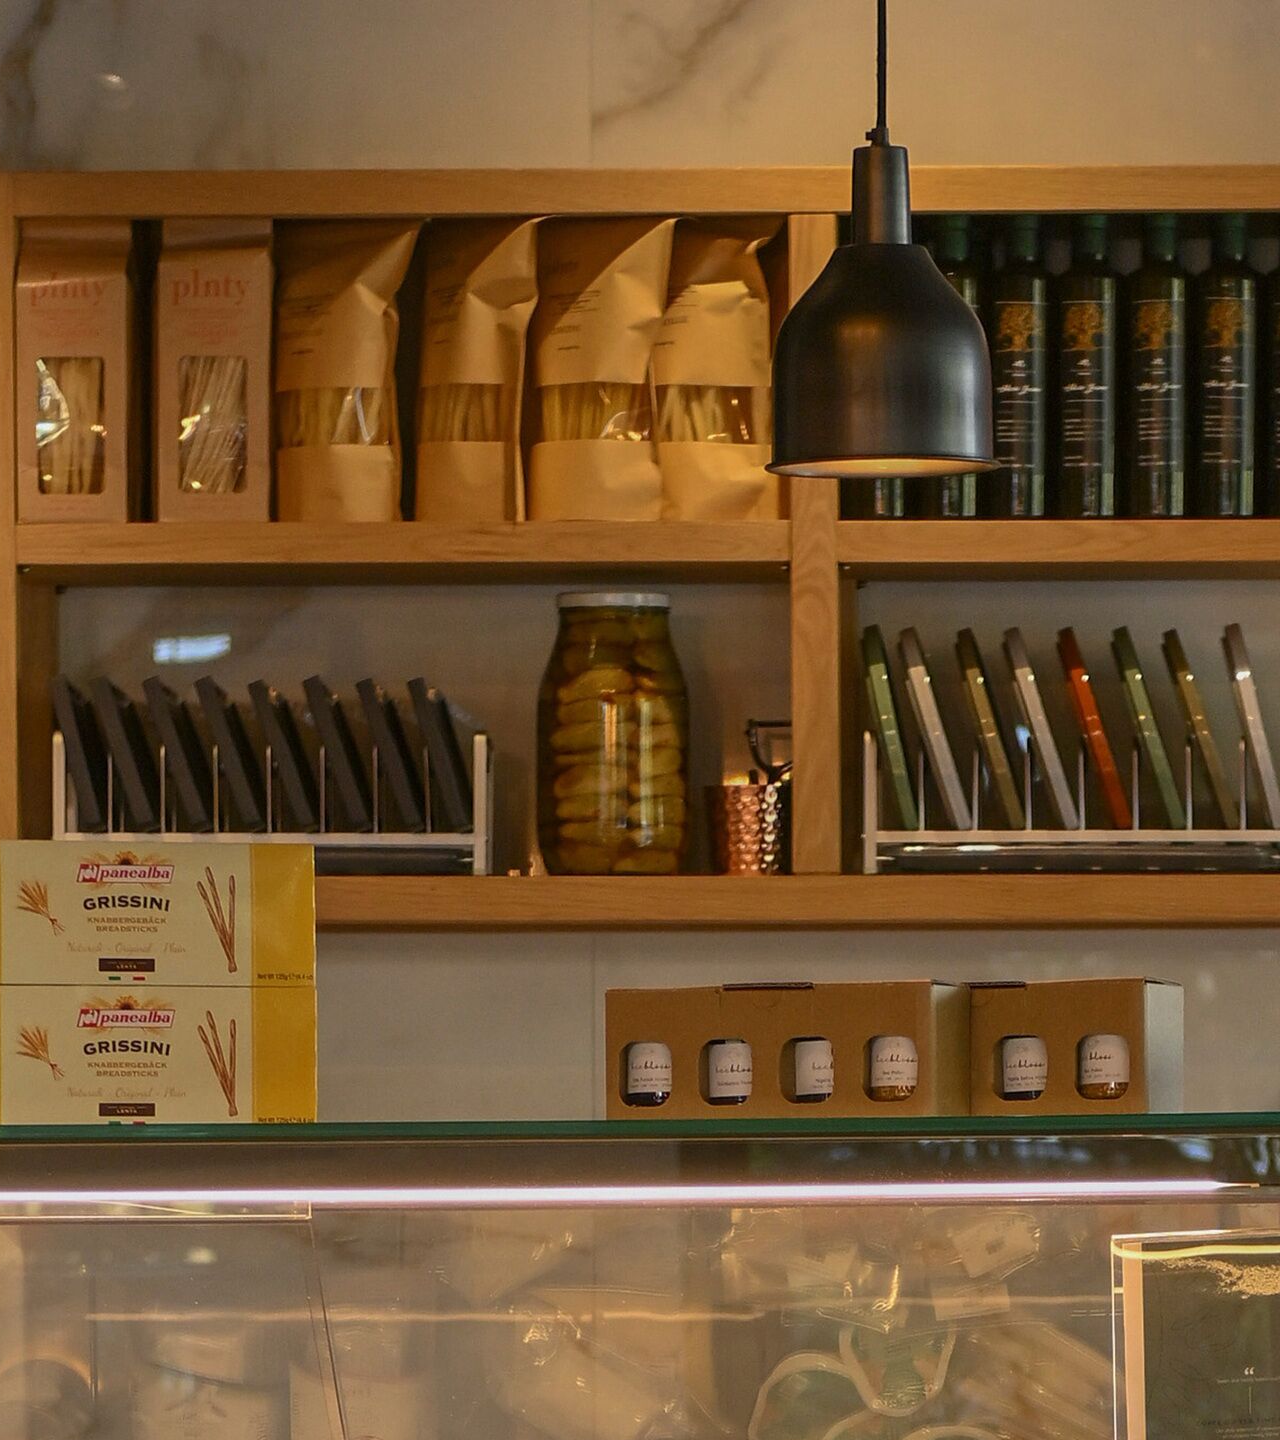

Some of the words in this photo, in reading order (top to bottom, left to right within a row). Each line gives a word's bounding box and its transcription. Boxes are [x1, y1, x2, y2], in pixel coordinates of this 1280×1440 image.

[171, 269, 251, 305] plnty
[99, 863, 171, 881] panealba
[82, 895, 170, 912] GRISSINI
[86, 916, 167, 925] KNABBERGEBÄCK
[96, 925, 158, 933] BREADSTICKS
[99, 1008, 171, 1026] panealba
[83, 1040, 171, 1057] GRISSINI
[87, 1062, 168, 1070] KNABBERGEBÄCK
[96, 1070, 159, 1078] BREADSTICKS
